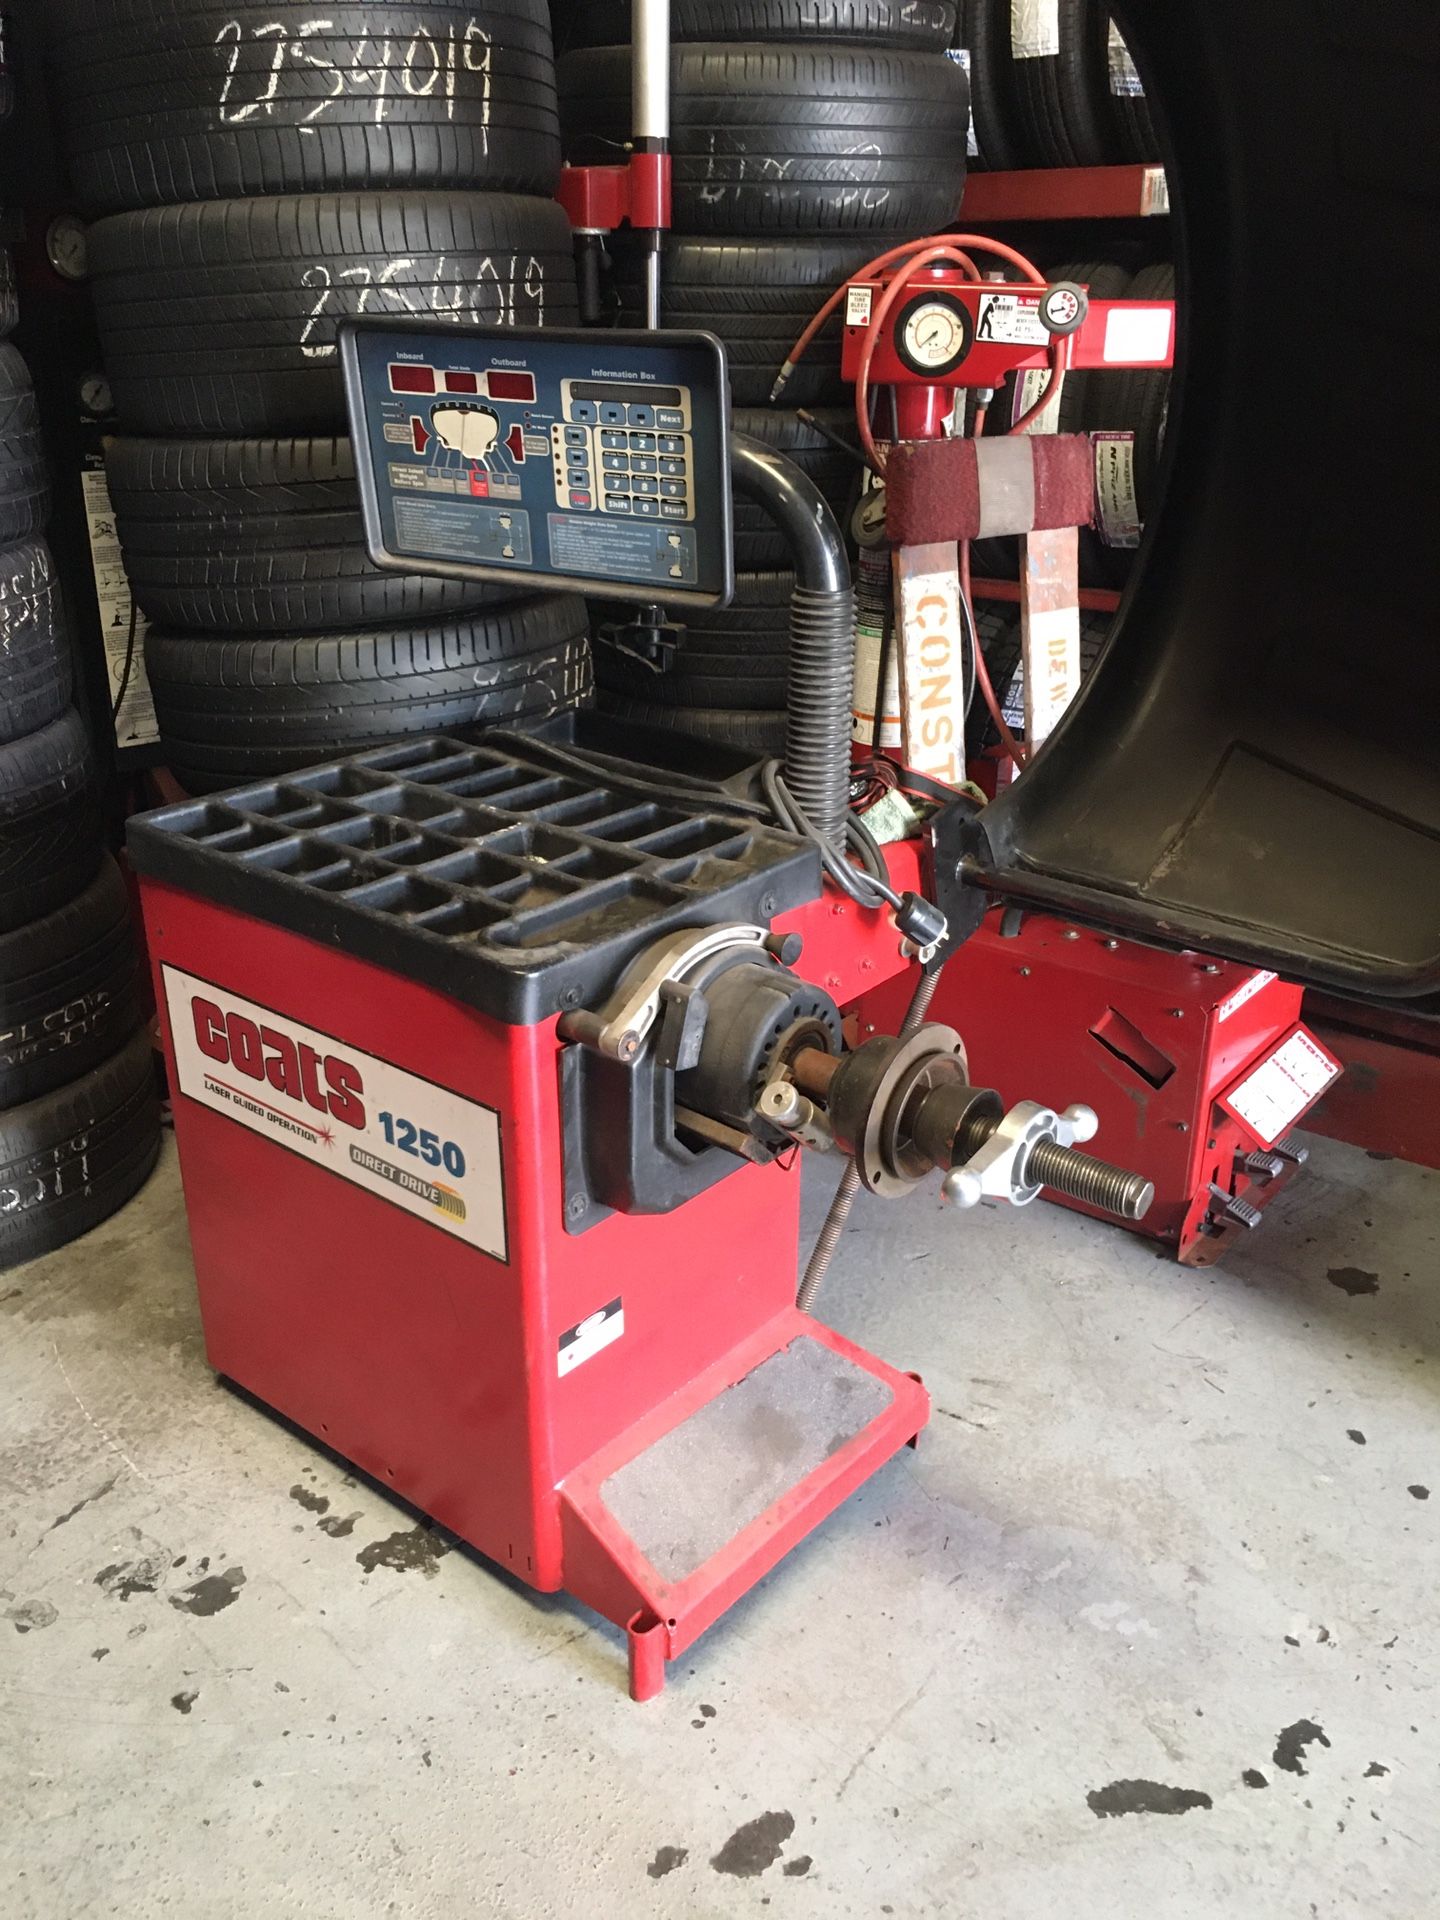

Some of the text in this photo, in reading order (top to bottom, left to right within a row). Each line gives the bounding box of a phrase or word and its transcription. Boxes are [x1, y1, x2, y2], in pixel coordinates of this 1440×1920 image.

[396, 351, 527, 367] Inboard Outboard
[591, 368, 656, 380] Information Box
[659, 414, 681, 424] Next
[610, 437, 675, 451] 1 2 3
[612, 458, 676, 473] 4 5 6
[613, 479, 677, 494] 7 8 9
[608, 500, 685, 515] Shift 0 Start
[915, 595, 957, 783] CONST
[204, 1080, 318, 1144] LASER GUIDED OPERATION
[378, 1111, 466, 1178] 1250
[353, 1147, 440, 1203] DIRECT DRIVE
